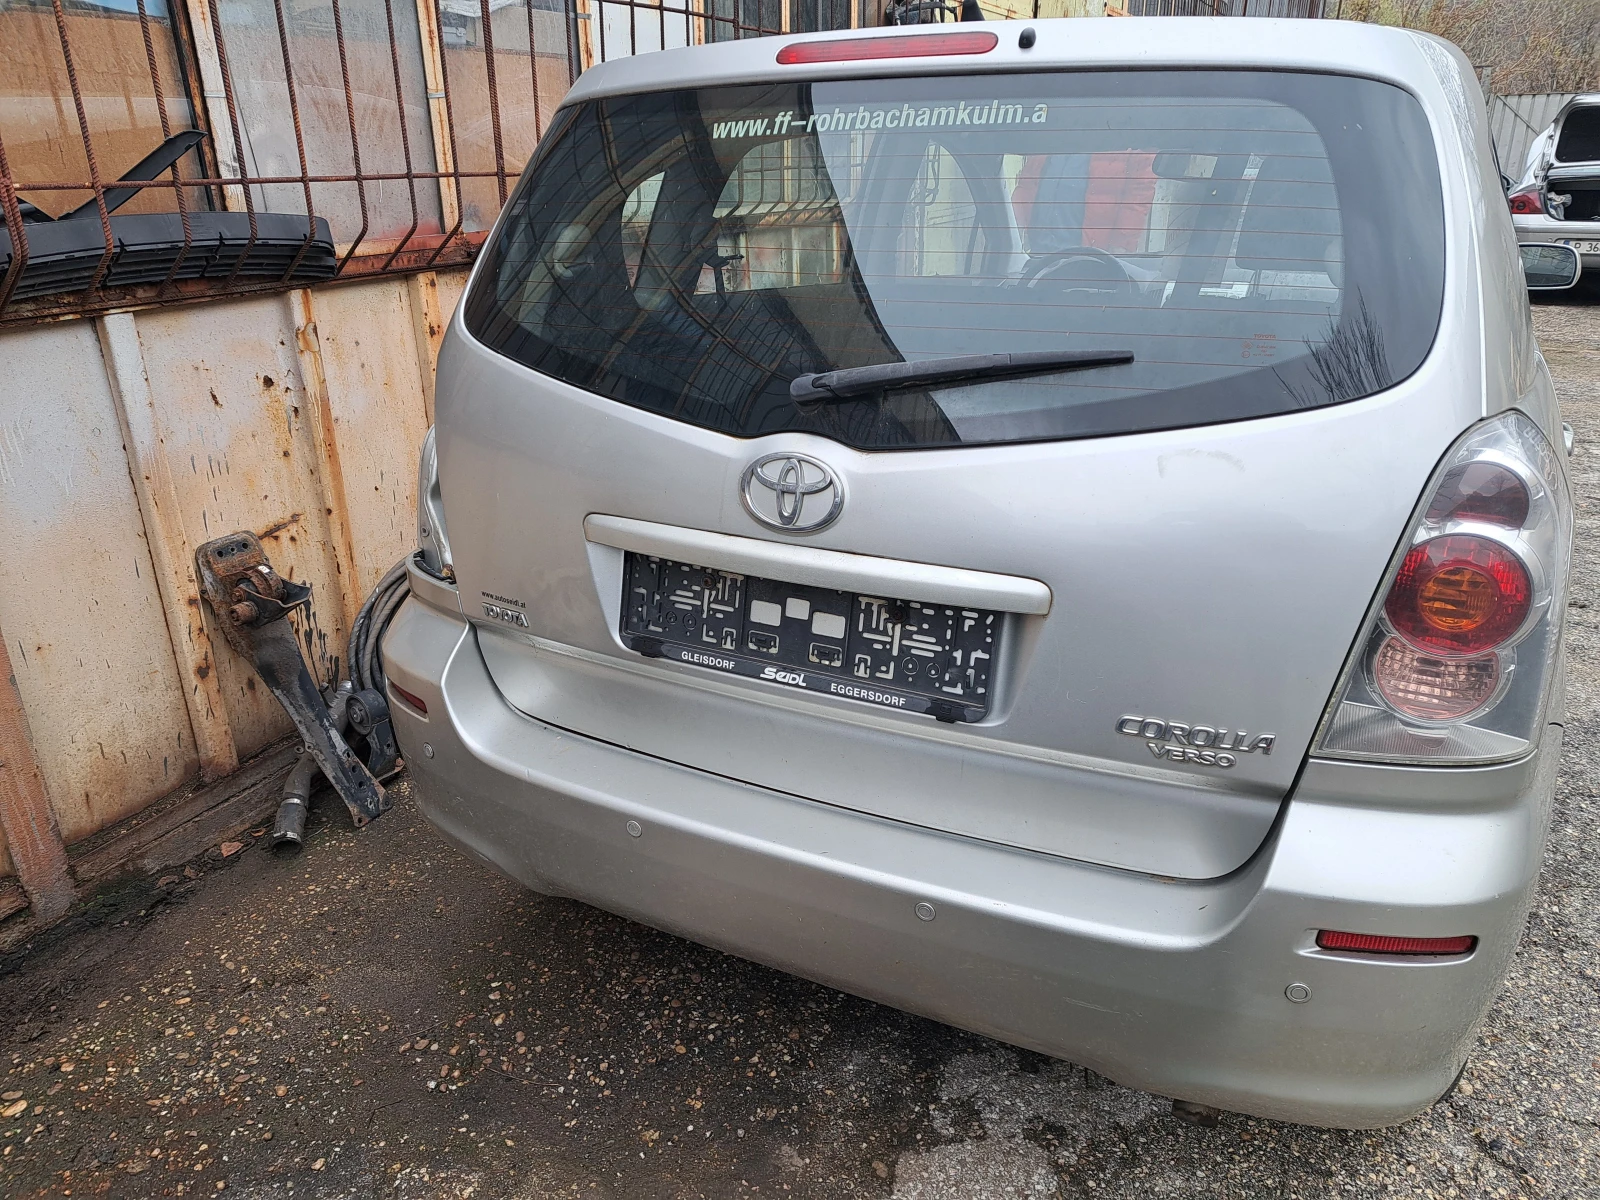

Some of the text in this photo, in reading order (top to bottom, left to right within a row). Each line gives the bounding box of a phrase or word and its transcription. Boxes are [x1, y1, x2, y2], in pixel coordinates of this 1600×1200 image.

[1586, 242, 1600, 252] 36
[482, 602, 530, 628] TOYOTA
[681, 651, 736, 670] GLEISDORF
[830, 682, 907, 708] EGGERSDORF
[1115, 713, 1277, 756] COROLLA
[1147, 741, 1237, 768] VERSO
